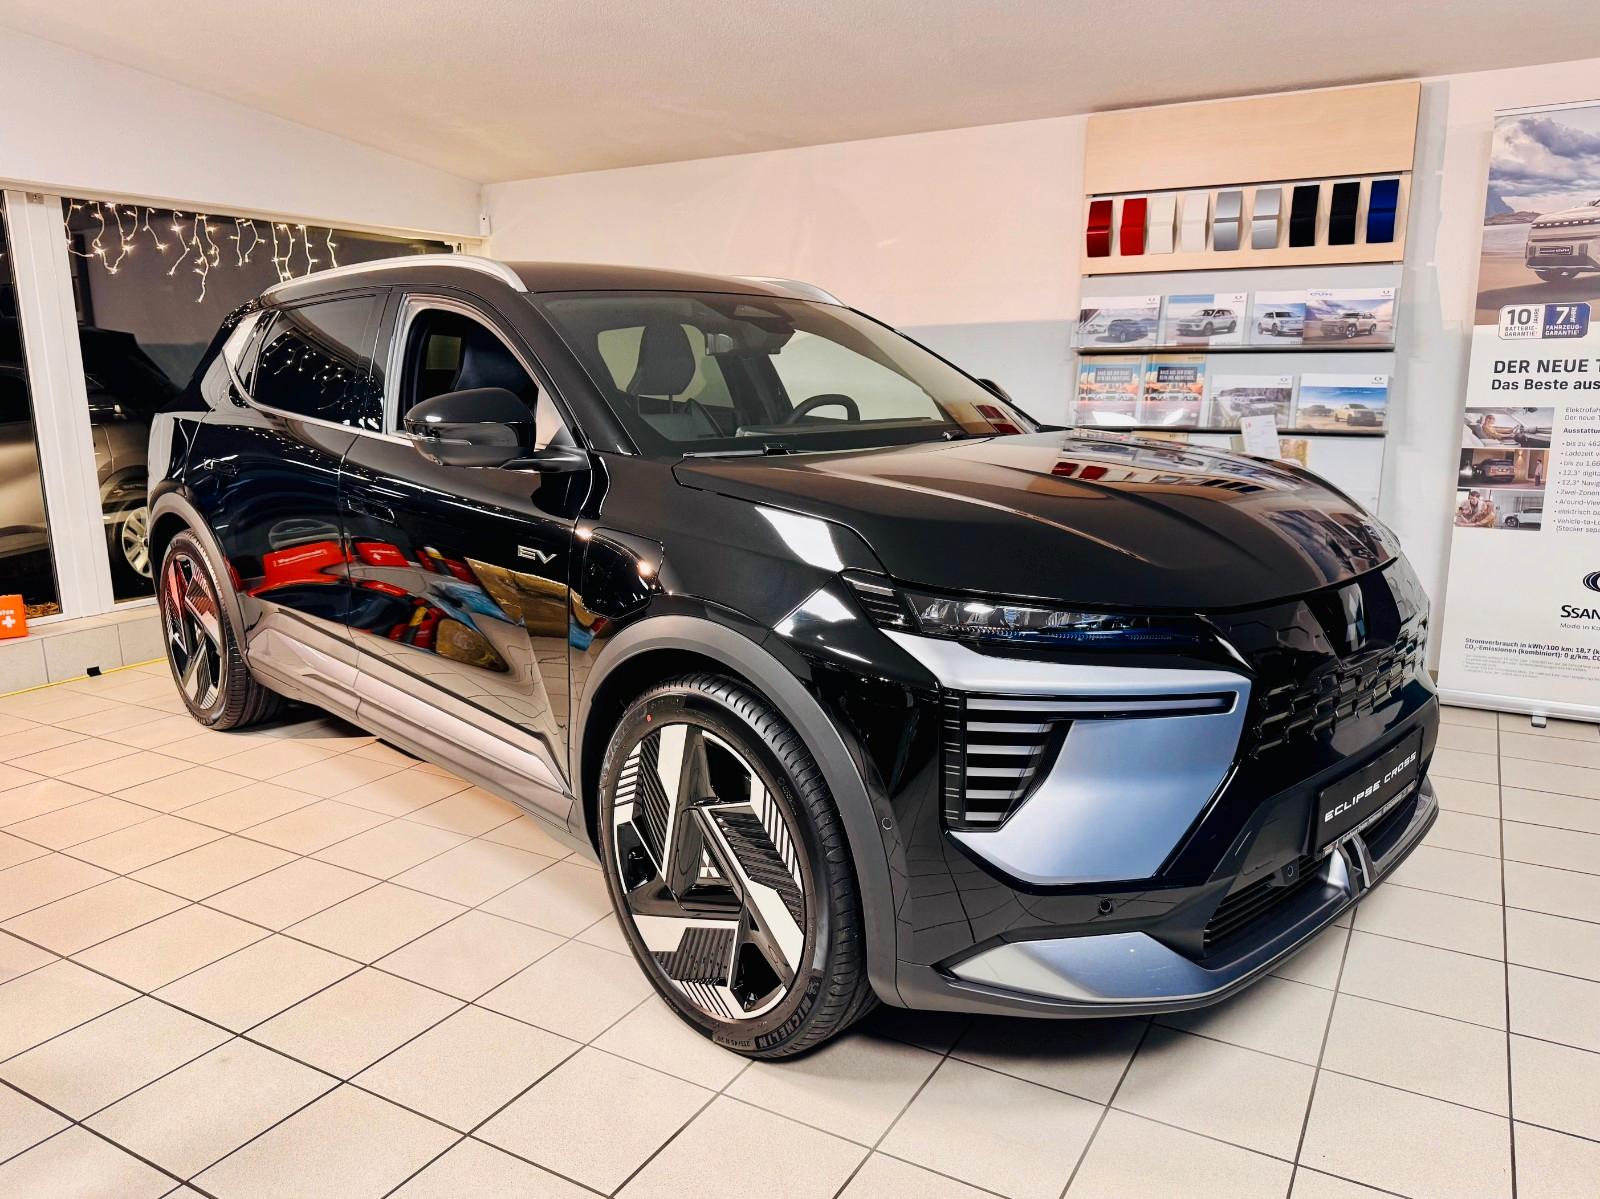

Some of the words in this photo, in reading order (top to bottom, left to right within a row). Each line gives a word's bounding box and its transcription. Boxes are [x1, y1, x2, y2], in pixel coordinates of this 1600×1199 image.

[1507, 309, 1531, 325] 10
[1556, 307, 1569, 324] 7
[1493, 360, 1530, 374] DER
[1537, 359, 1589, 373] NEUE
[1492, 379, 1519, 390] Das
[1524, 379, 1568, 390] Beste
[1573, 381, 1600, 390] aus
[518, 544, 557, 564] EV
[1465, 638, 1518, 648] Stromverbrauch
[1528, 643, 1560, 651] kWh/100
[1518, 649, 1563, 659] (kombiniert):
[1324, 780, 1381, 823] ECLIPSE
[1384, 750, 1417, 783] CROSS
[758, 996, 813, 1048] MICHELIN
